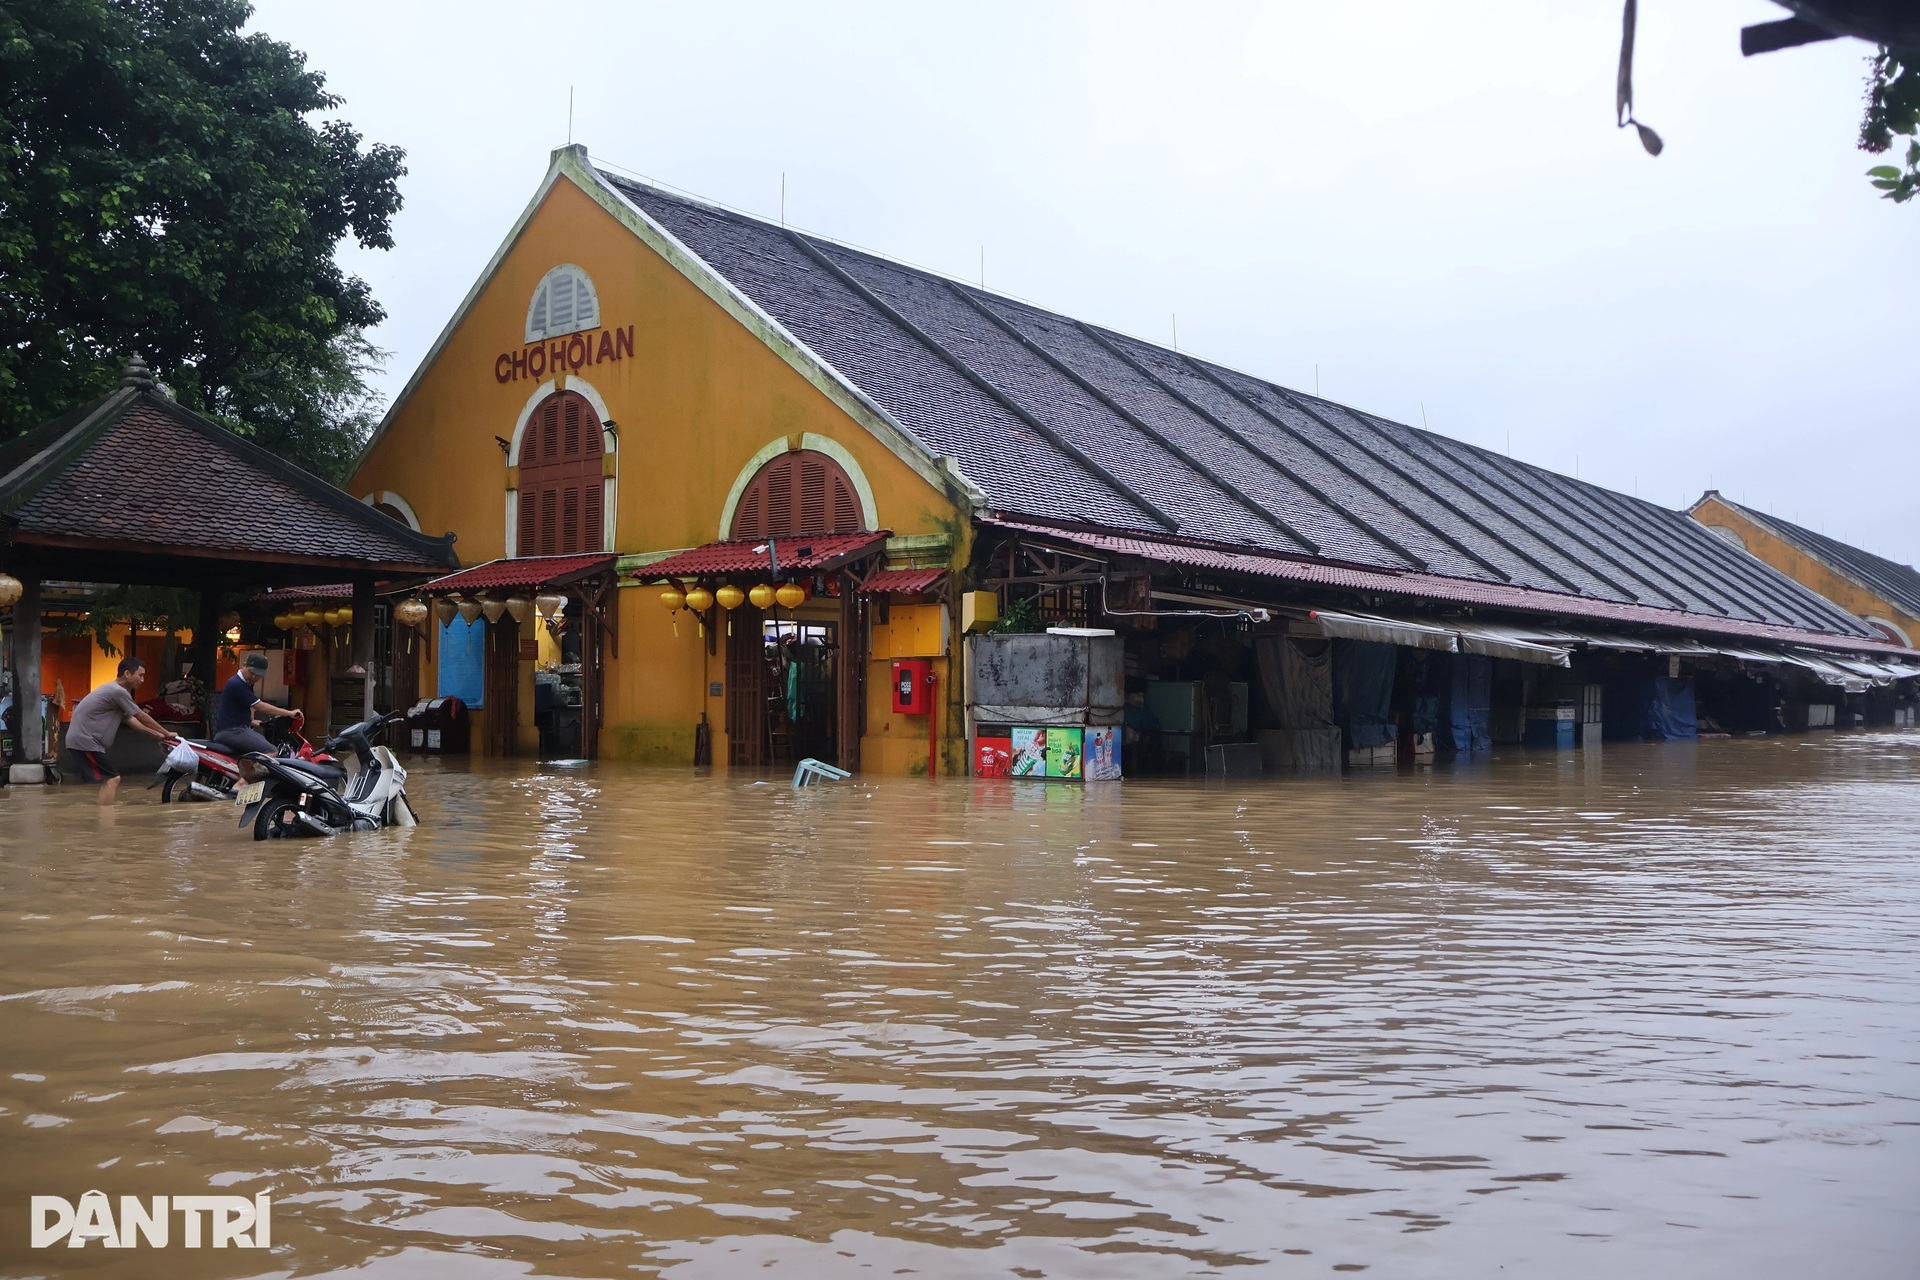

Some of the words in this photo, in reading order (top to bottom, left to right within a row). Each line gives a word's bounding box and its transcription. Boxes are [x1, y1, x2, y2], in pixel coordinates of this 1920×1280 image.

[495, 340, 547, 384] CHỢ
[551, 331, 593, 376] HỘI
[596, 325, 634, 364] AN
